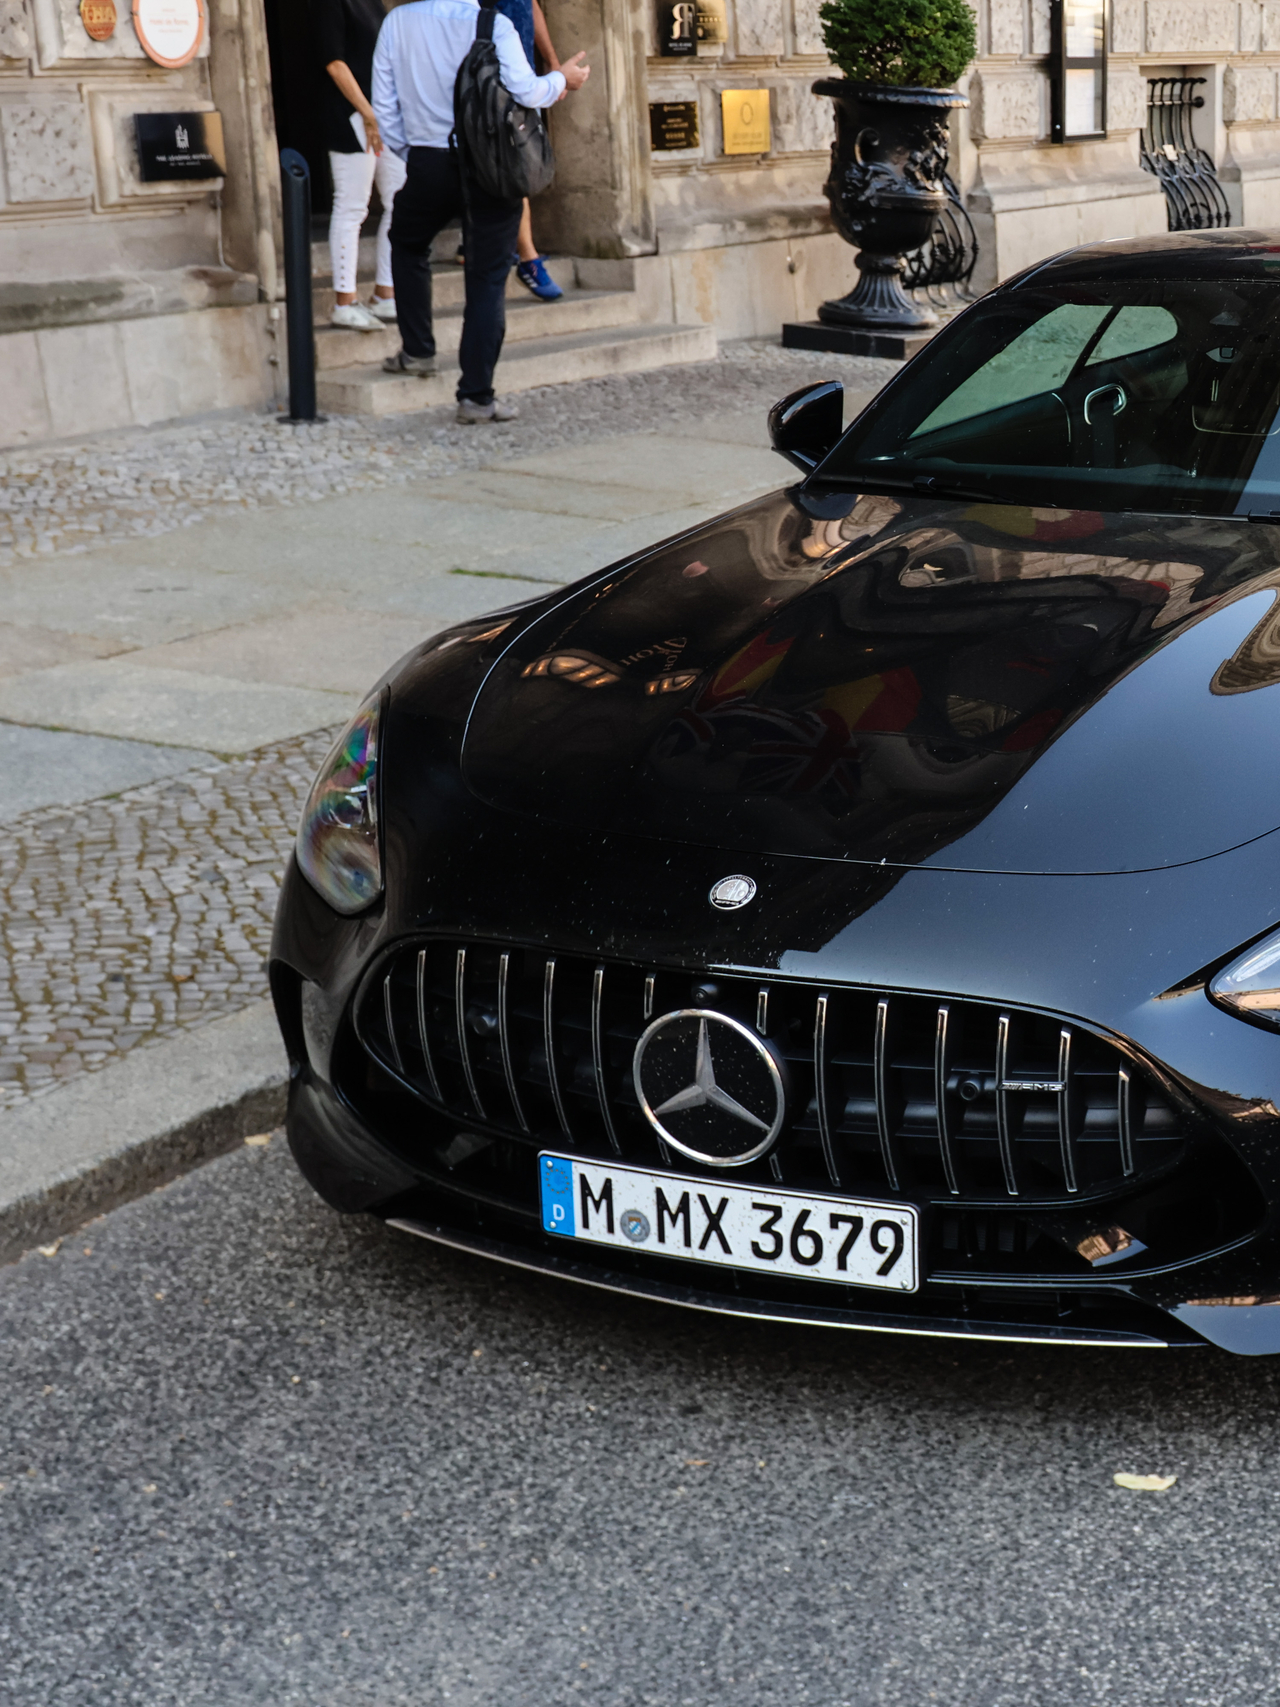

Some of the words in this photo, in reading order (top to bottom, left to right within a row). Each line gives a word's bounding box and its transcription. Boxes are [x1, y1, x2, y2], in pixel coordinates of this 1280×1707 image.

[552, 1203, 566, 1221] D
[579, 1173, 615, 1234] M
[655, 1186, 733, 1255] MX
[751, 1202, 904, 1276] 3679
